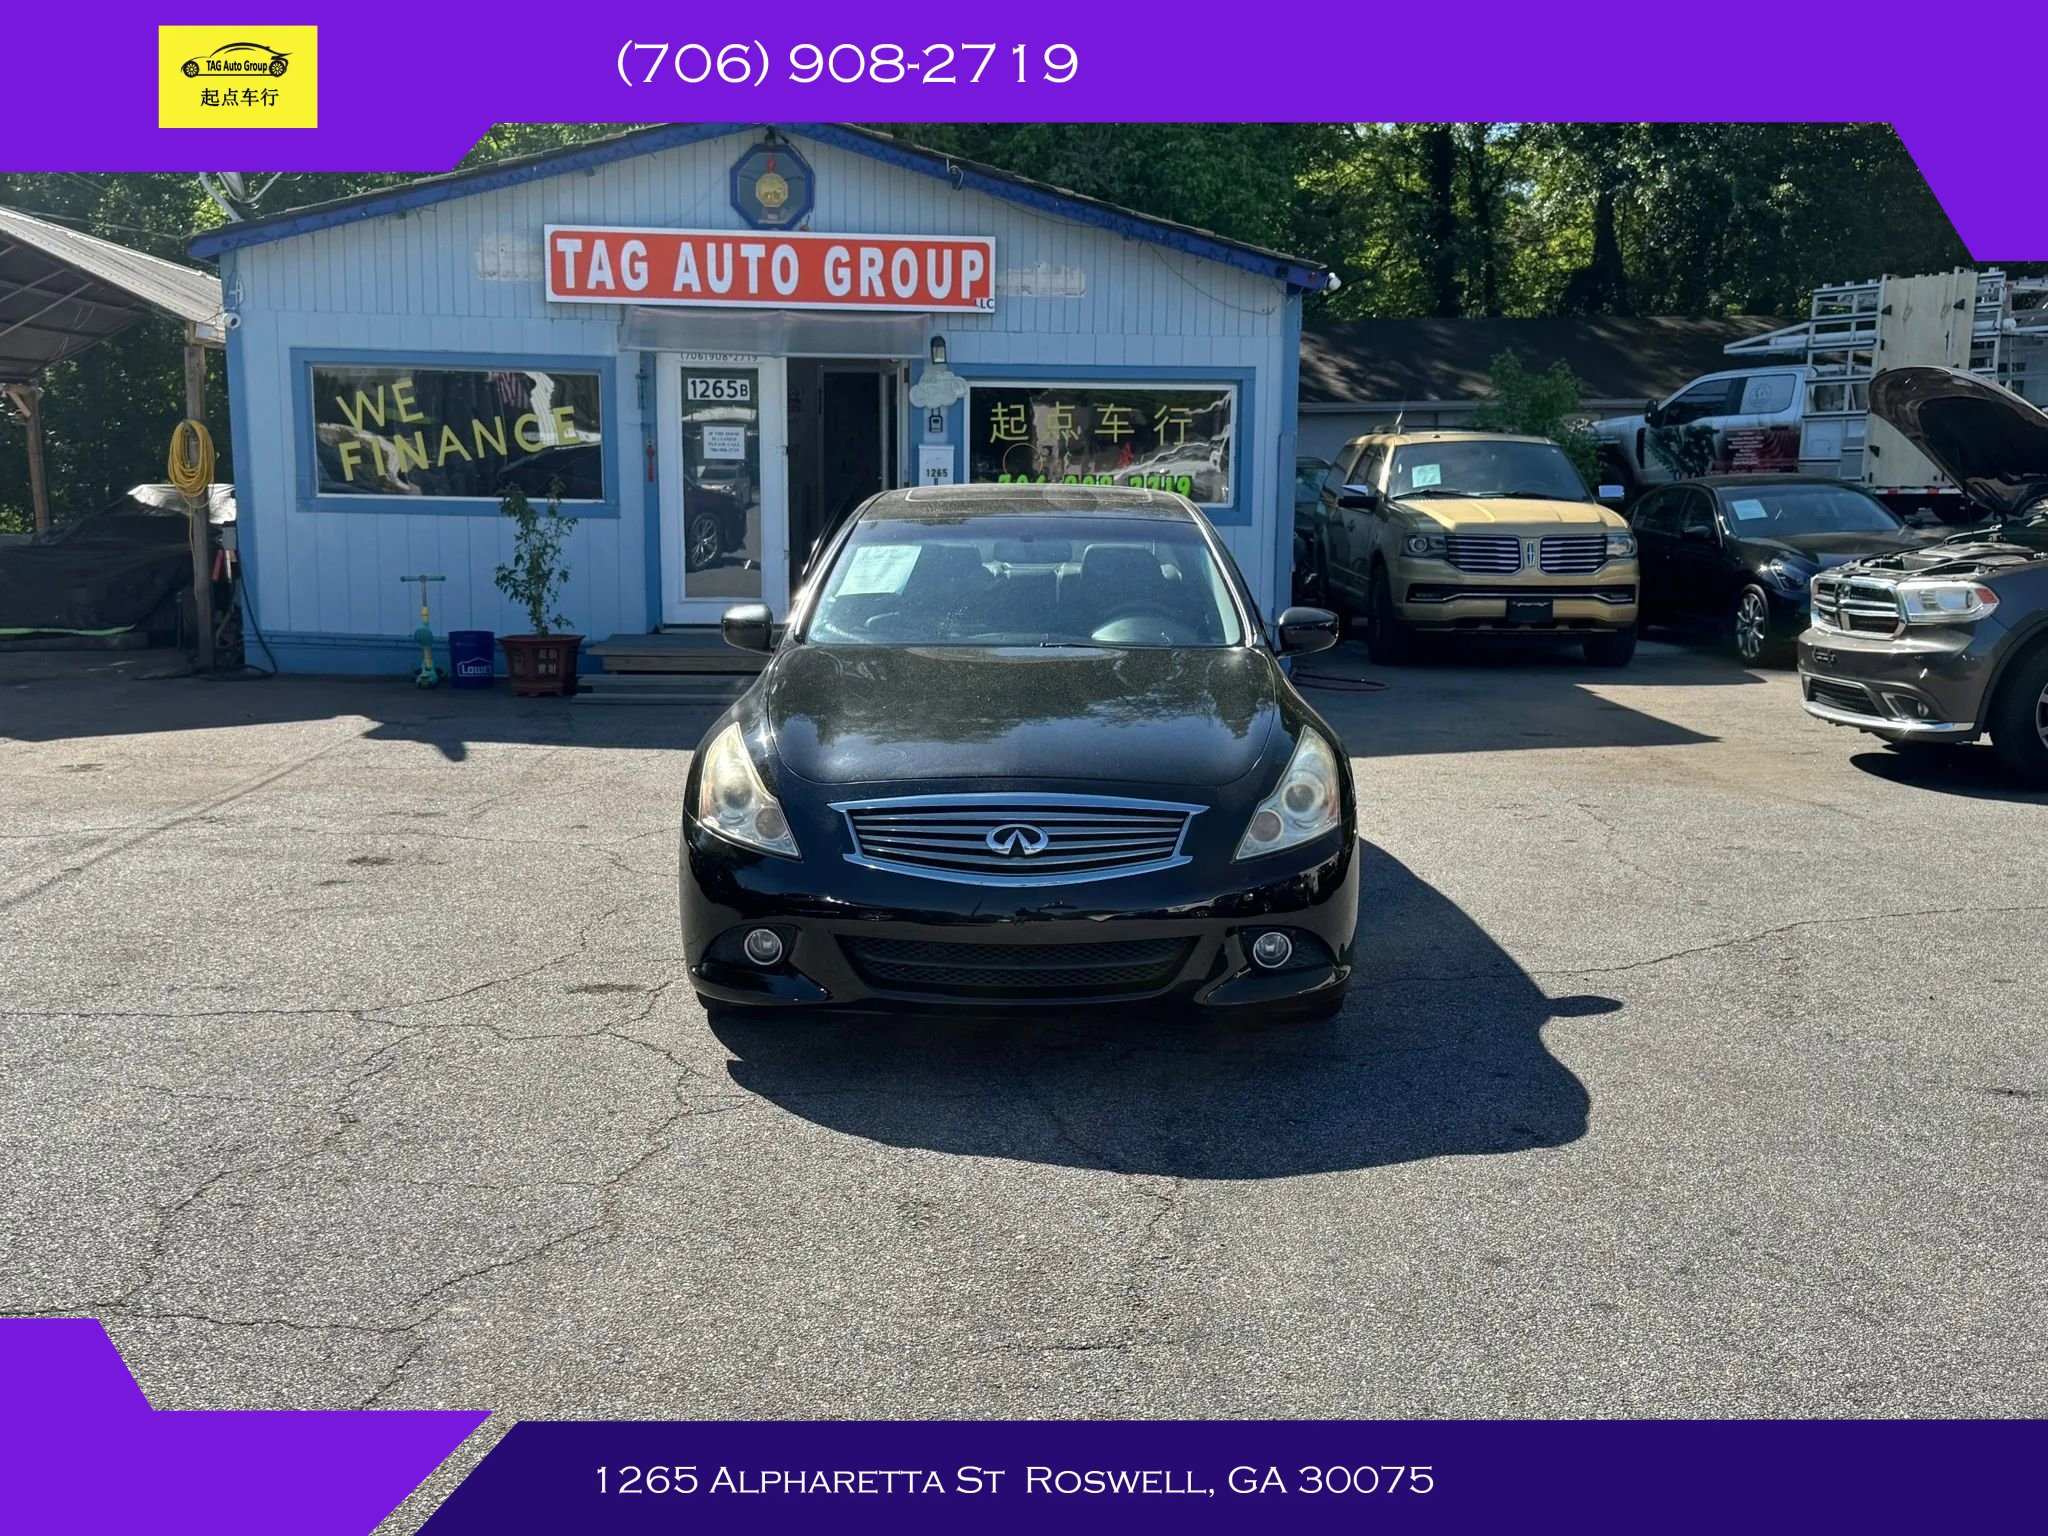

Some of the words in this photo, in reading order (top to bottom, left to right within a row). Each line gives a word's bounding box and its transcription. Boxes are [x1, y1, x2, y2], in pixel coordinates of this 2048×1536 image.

[557, 238, 649, 291] TAG
[673, 241, 799, 295] AUTO
[824, 245, 984, 299] GROUP
[336, 377, 425, 432] WE
[989, 401, 1193, 446] 起点车行
[339, 405, 581, 482] FINANCE
[926, 468, 948, 478] 1265
